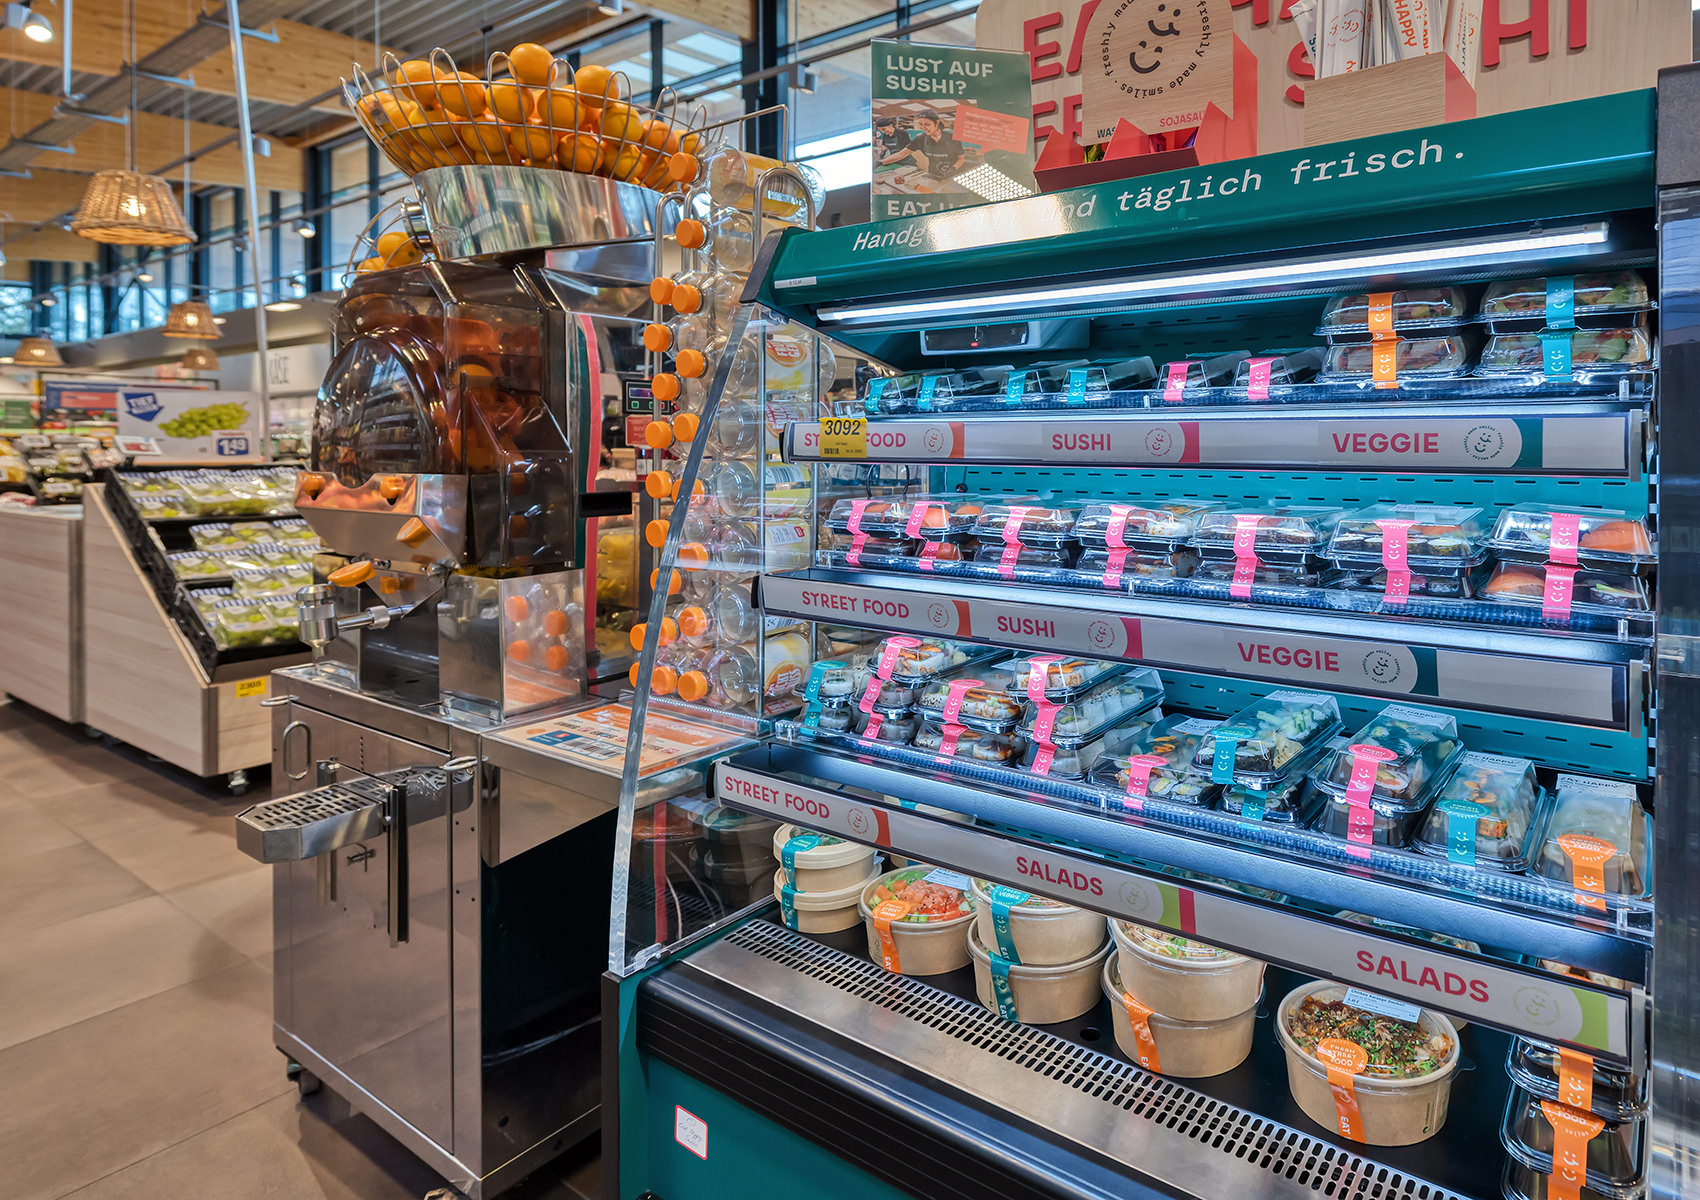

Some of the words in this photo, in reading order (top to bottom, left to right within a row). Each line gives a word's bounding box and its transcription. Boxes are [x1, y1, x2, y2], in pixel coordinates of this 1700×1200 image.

[1195, 0, 1211, 58] freshly
[1100, 21, 1116, 77] freshly
[886, 55, 943, 74] LUST
[949, 61, 994, 78] AUF
[1169, 62, 1198, 89] made
[886, 74, 968, 95] SUSHI?
[1120, 83, 1163, 99] smiles
[1116, 164, 1262, 214] täglich
[1290, 138, 1464, 185] frisch.
[887, 199, 933, 217] EAT
[824, 420, 861, 436] 3092
[1052, 433, 1111, 451] SUSHI
[1332, 432, 1439, 454] VEGGIE
[802, 591, 857, 613] STREET
[863, 598, 910, 618] FOOD
[997, 615, 1055, 638] SUSHI
[1237, 642, 1340, 672] VEGGIE
[724, 775, 780, 805] STREET
[784, 792, 830, 820] FOOD
[1015, 856, 1104, 897] SALADS
[1356, 950, 1489, 1003] SALADS
[1340, 1115, 1351, 1136] EAT
[1557, 1110, 1587, 1126] FOOD
